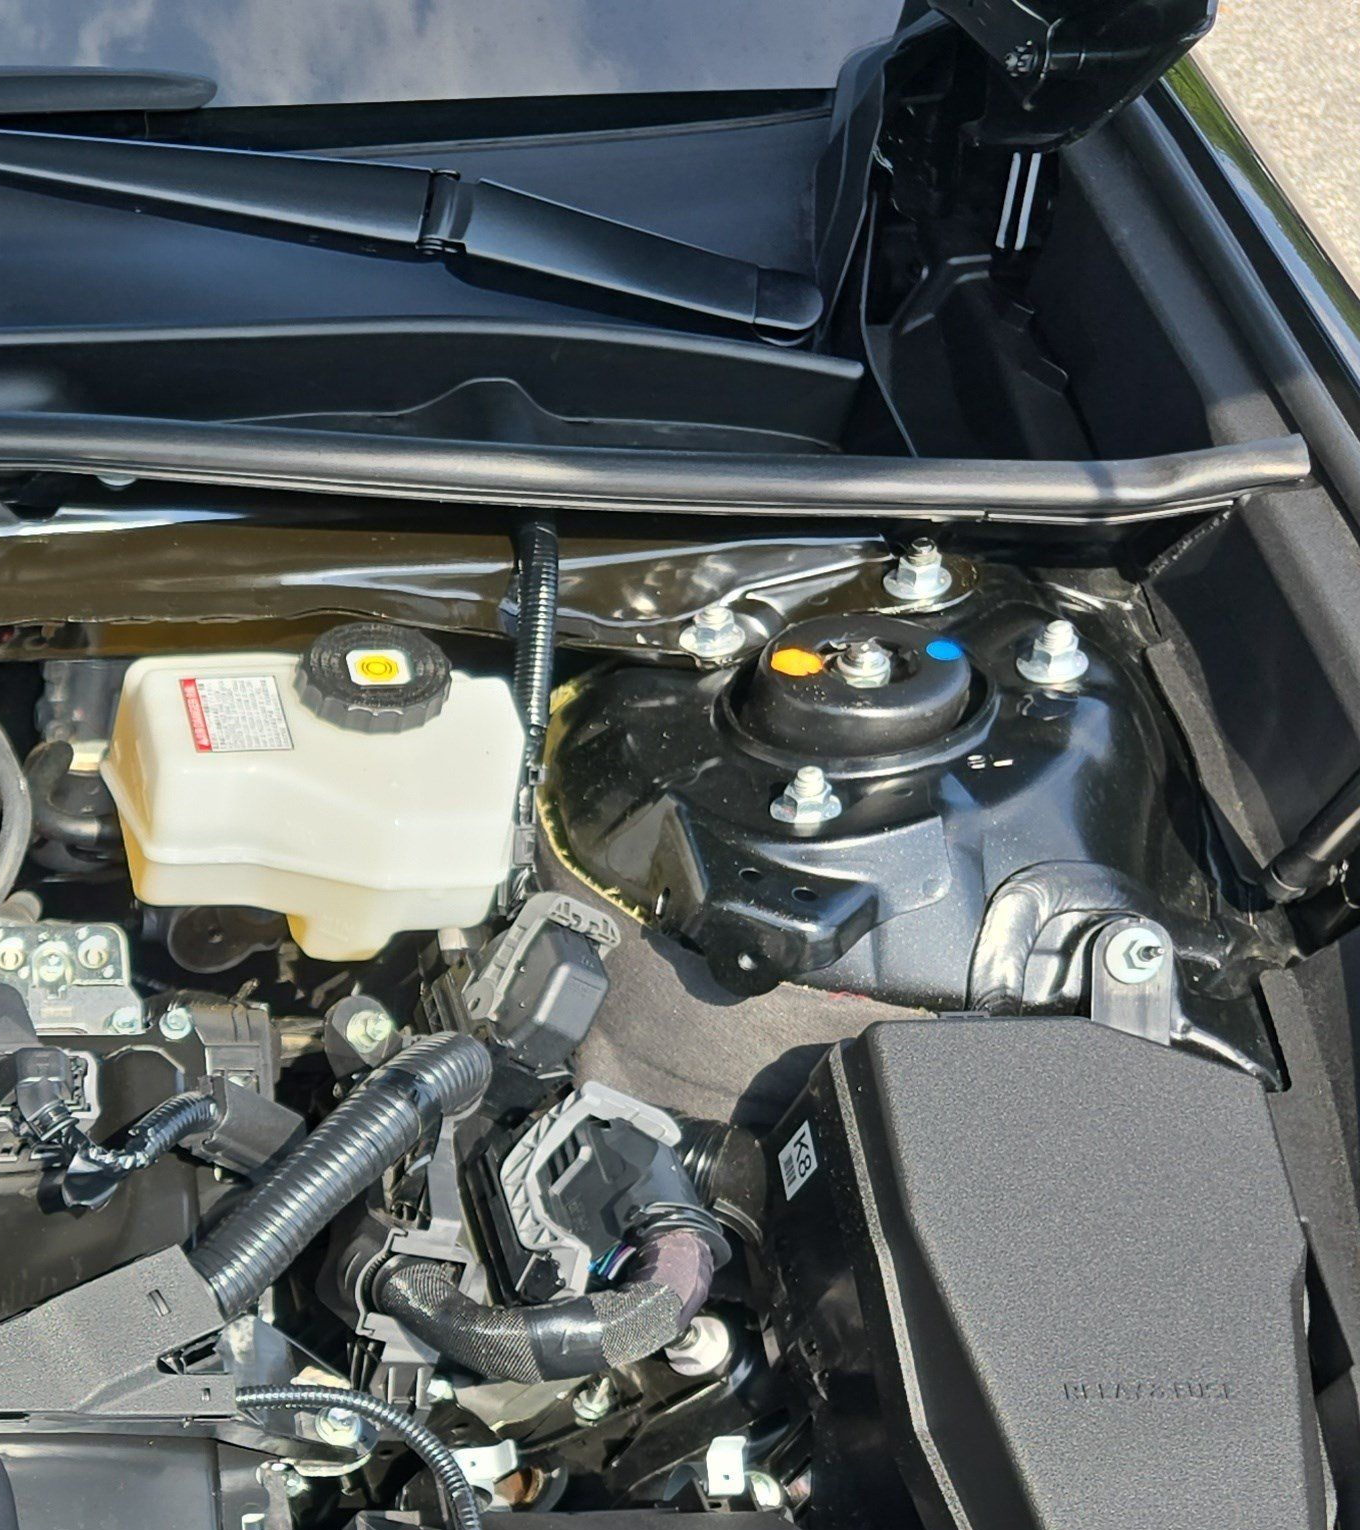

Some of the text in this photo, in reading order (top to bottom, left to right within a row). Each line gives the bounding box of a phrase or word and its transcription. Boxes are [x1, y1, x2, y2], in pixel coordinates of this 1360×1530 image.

[793, 1132, 812, 1178] K8
[1063, 1383, 1145, 1400] RELAY
[1172, 1383, 1234, 1400] FUSE
